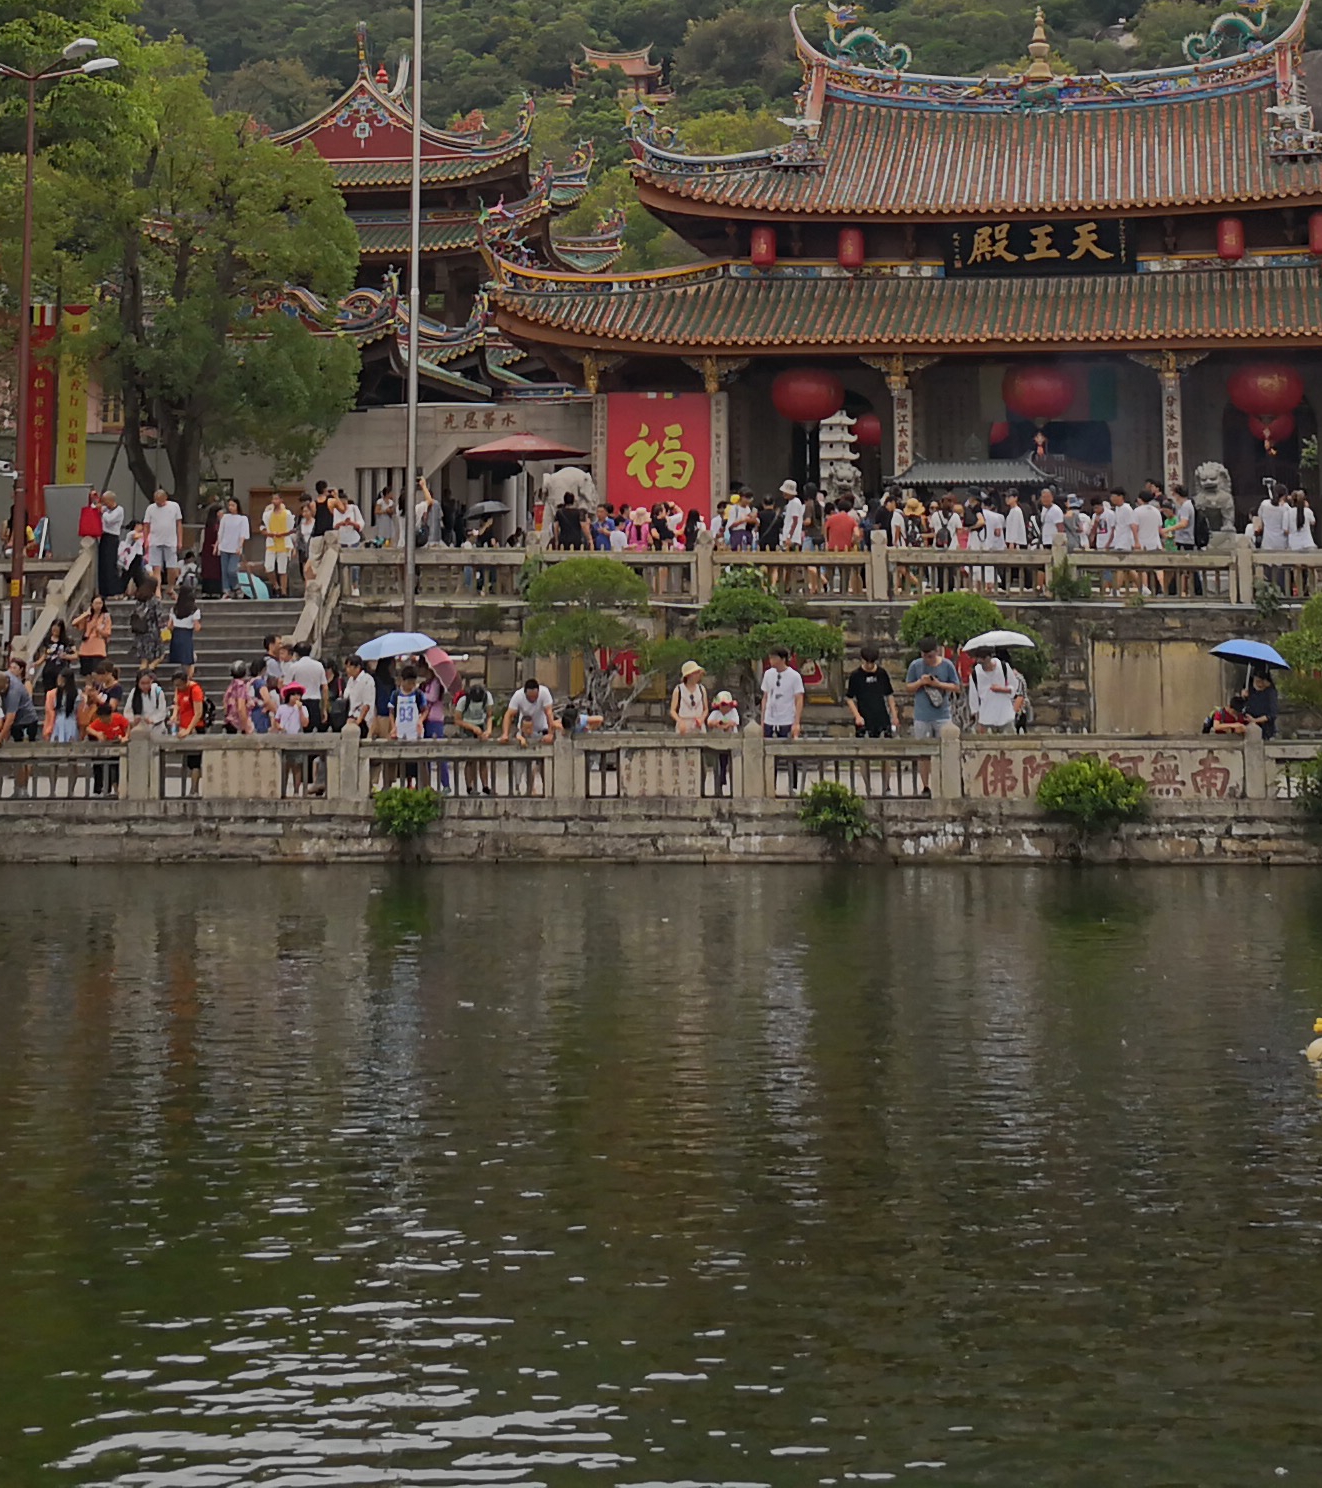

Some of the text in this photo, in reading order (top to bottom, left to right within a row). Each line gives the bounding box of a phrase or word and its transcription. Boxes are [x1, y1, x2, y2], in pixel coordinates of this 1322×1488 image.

[966, 221, 1115, 266] 天王殿
[622, 422, 696, 490] 福
